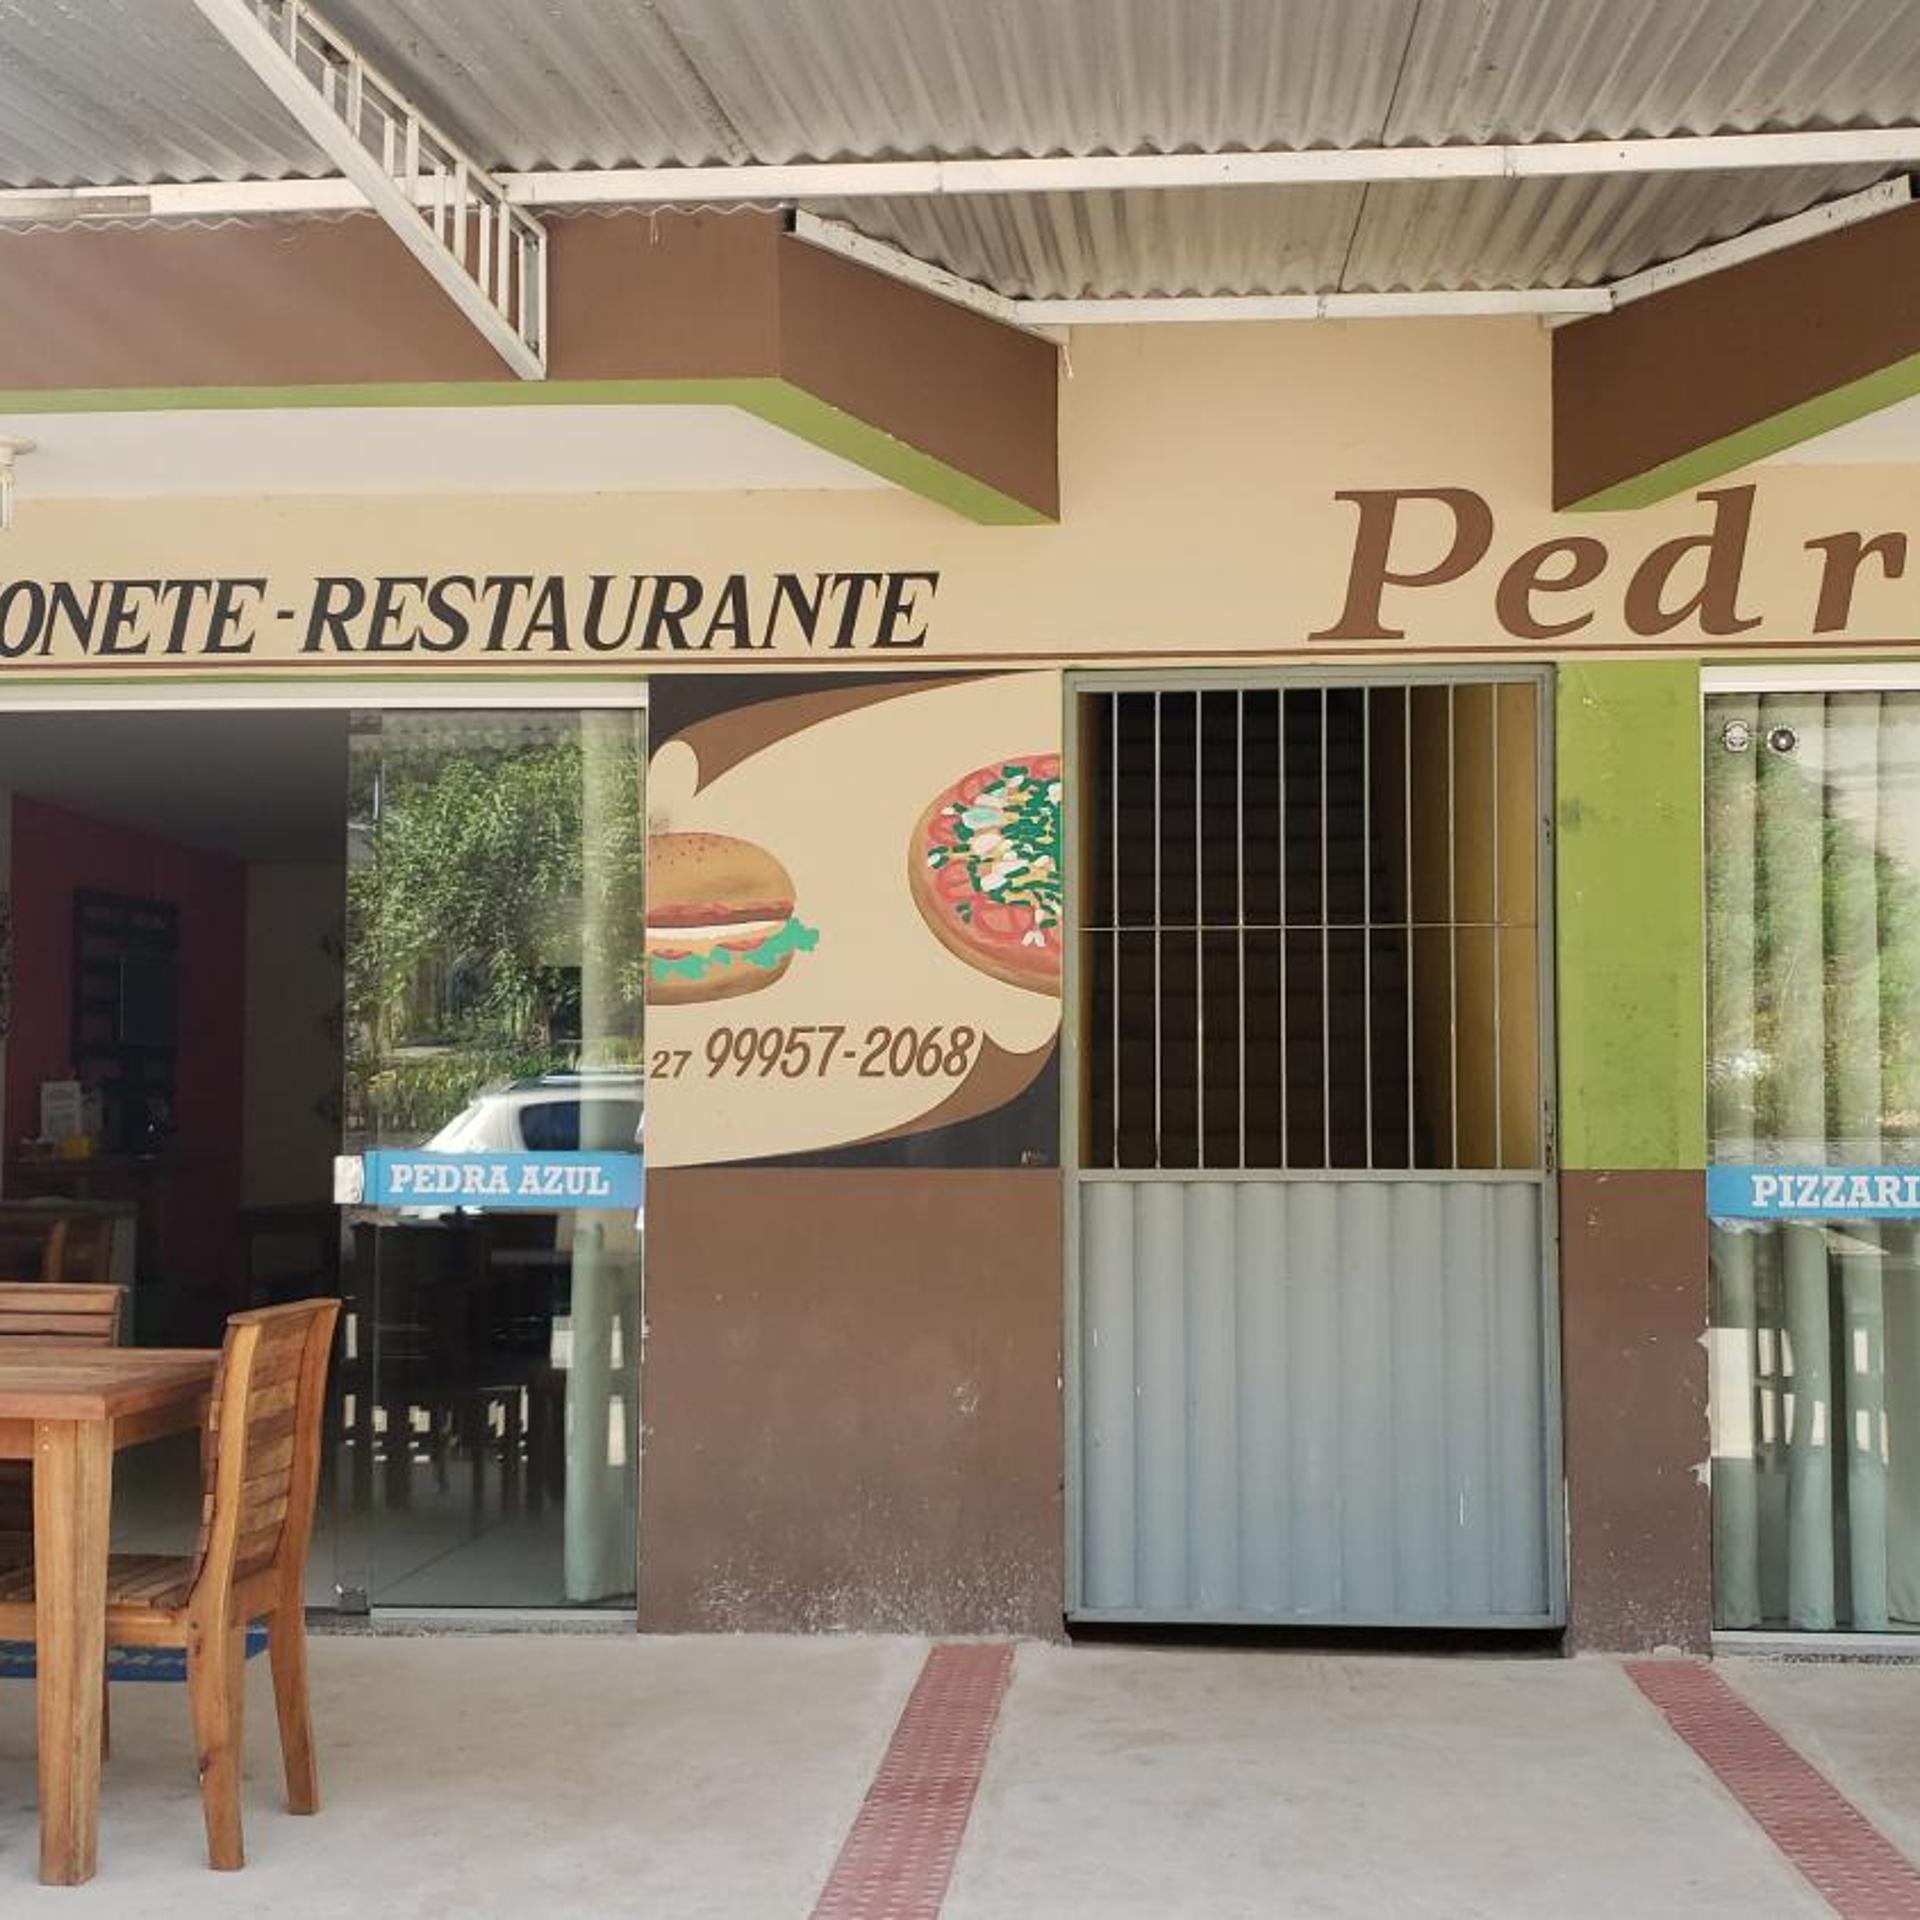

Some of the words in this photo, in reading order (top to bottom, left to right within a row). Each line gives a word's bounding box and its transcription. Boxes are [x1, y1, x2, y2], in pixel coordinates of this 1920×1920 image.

[1308, 483, 1907, 641] Pedr
[298, 570, 939, 653] RESTAURANTE
[650, 1050, 692, 1079] 27
[705, 1025, 976, 1078] 99957-2068
[389, 1163, 510, 1194] PEDRA
[517, 1166, 610, 1195] AZUL
[1751, 1174, 1920, 1208] PIZZARI
